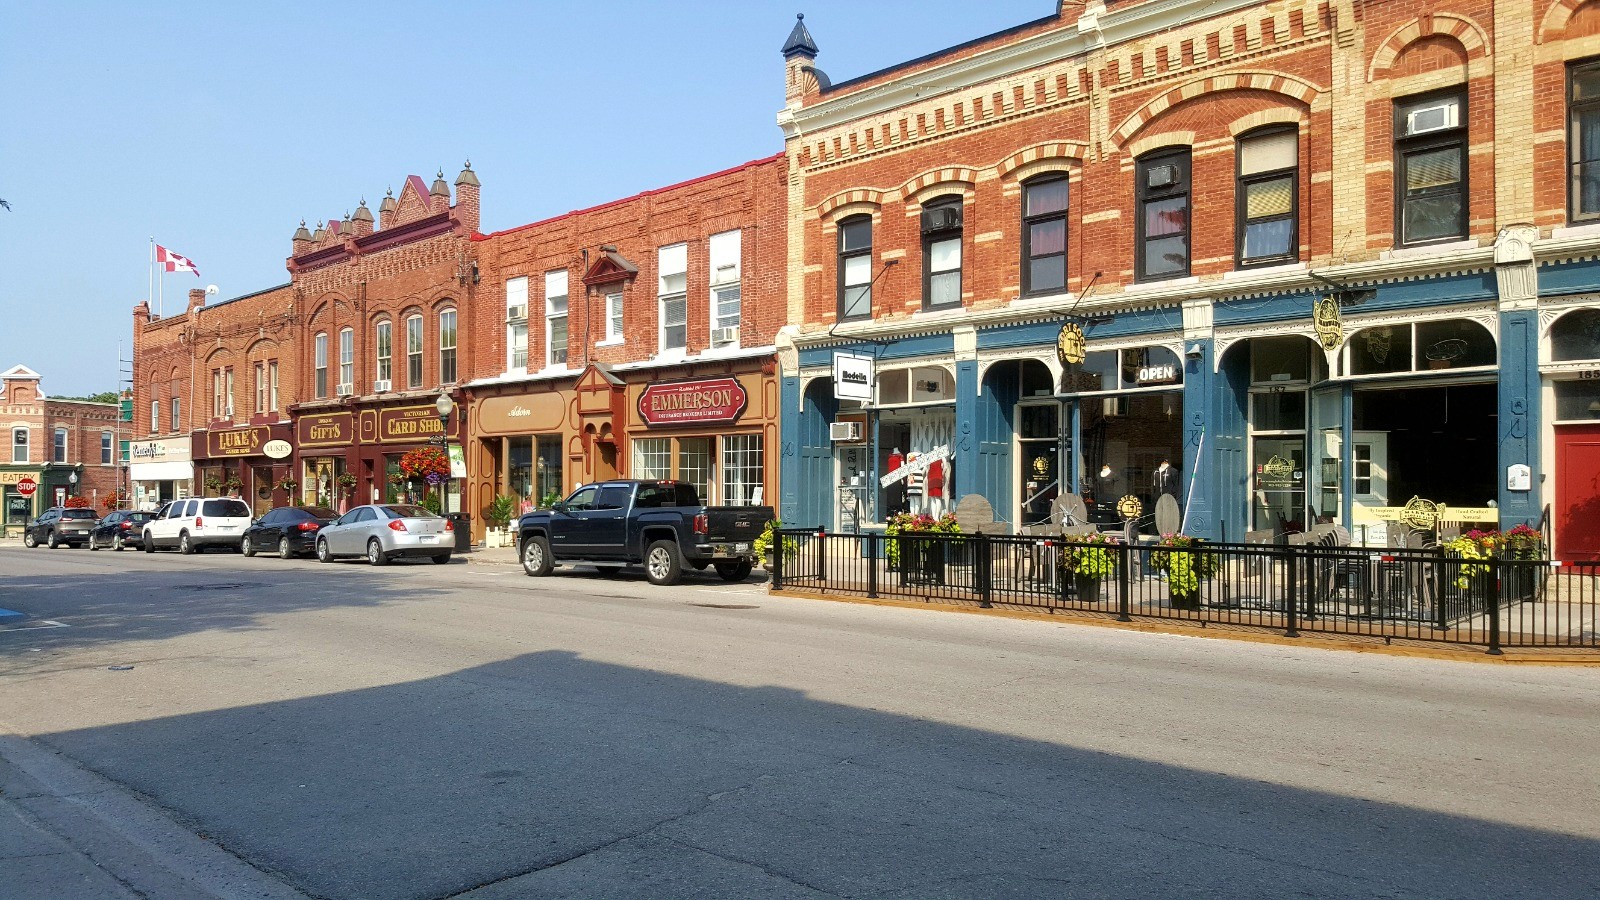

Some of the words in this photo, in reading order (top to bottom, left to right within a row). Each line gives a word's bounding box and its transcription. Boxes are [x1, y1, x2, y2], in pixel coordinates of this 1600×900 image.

[1139, 366, 1173, 380] OPEN
[651, 389, 733, 411] EMMERSON
[310, 423, 341, 439] GIFTS
[387, 418, 417, 435] CARD
[218, 429, 259, 450] LUKE'S
[18, 482, 36, 491] STOP
